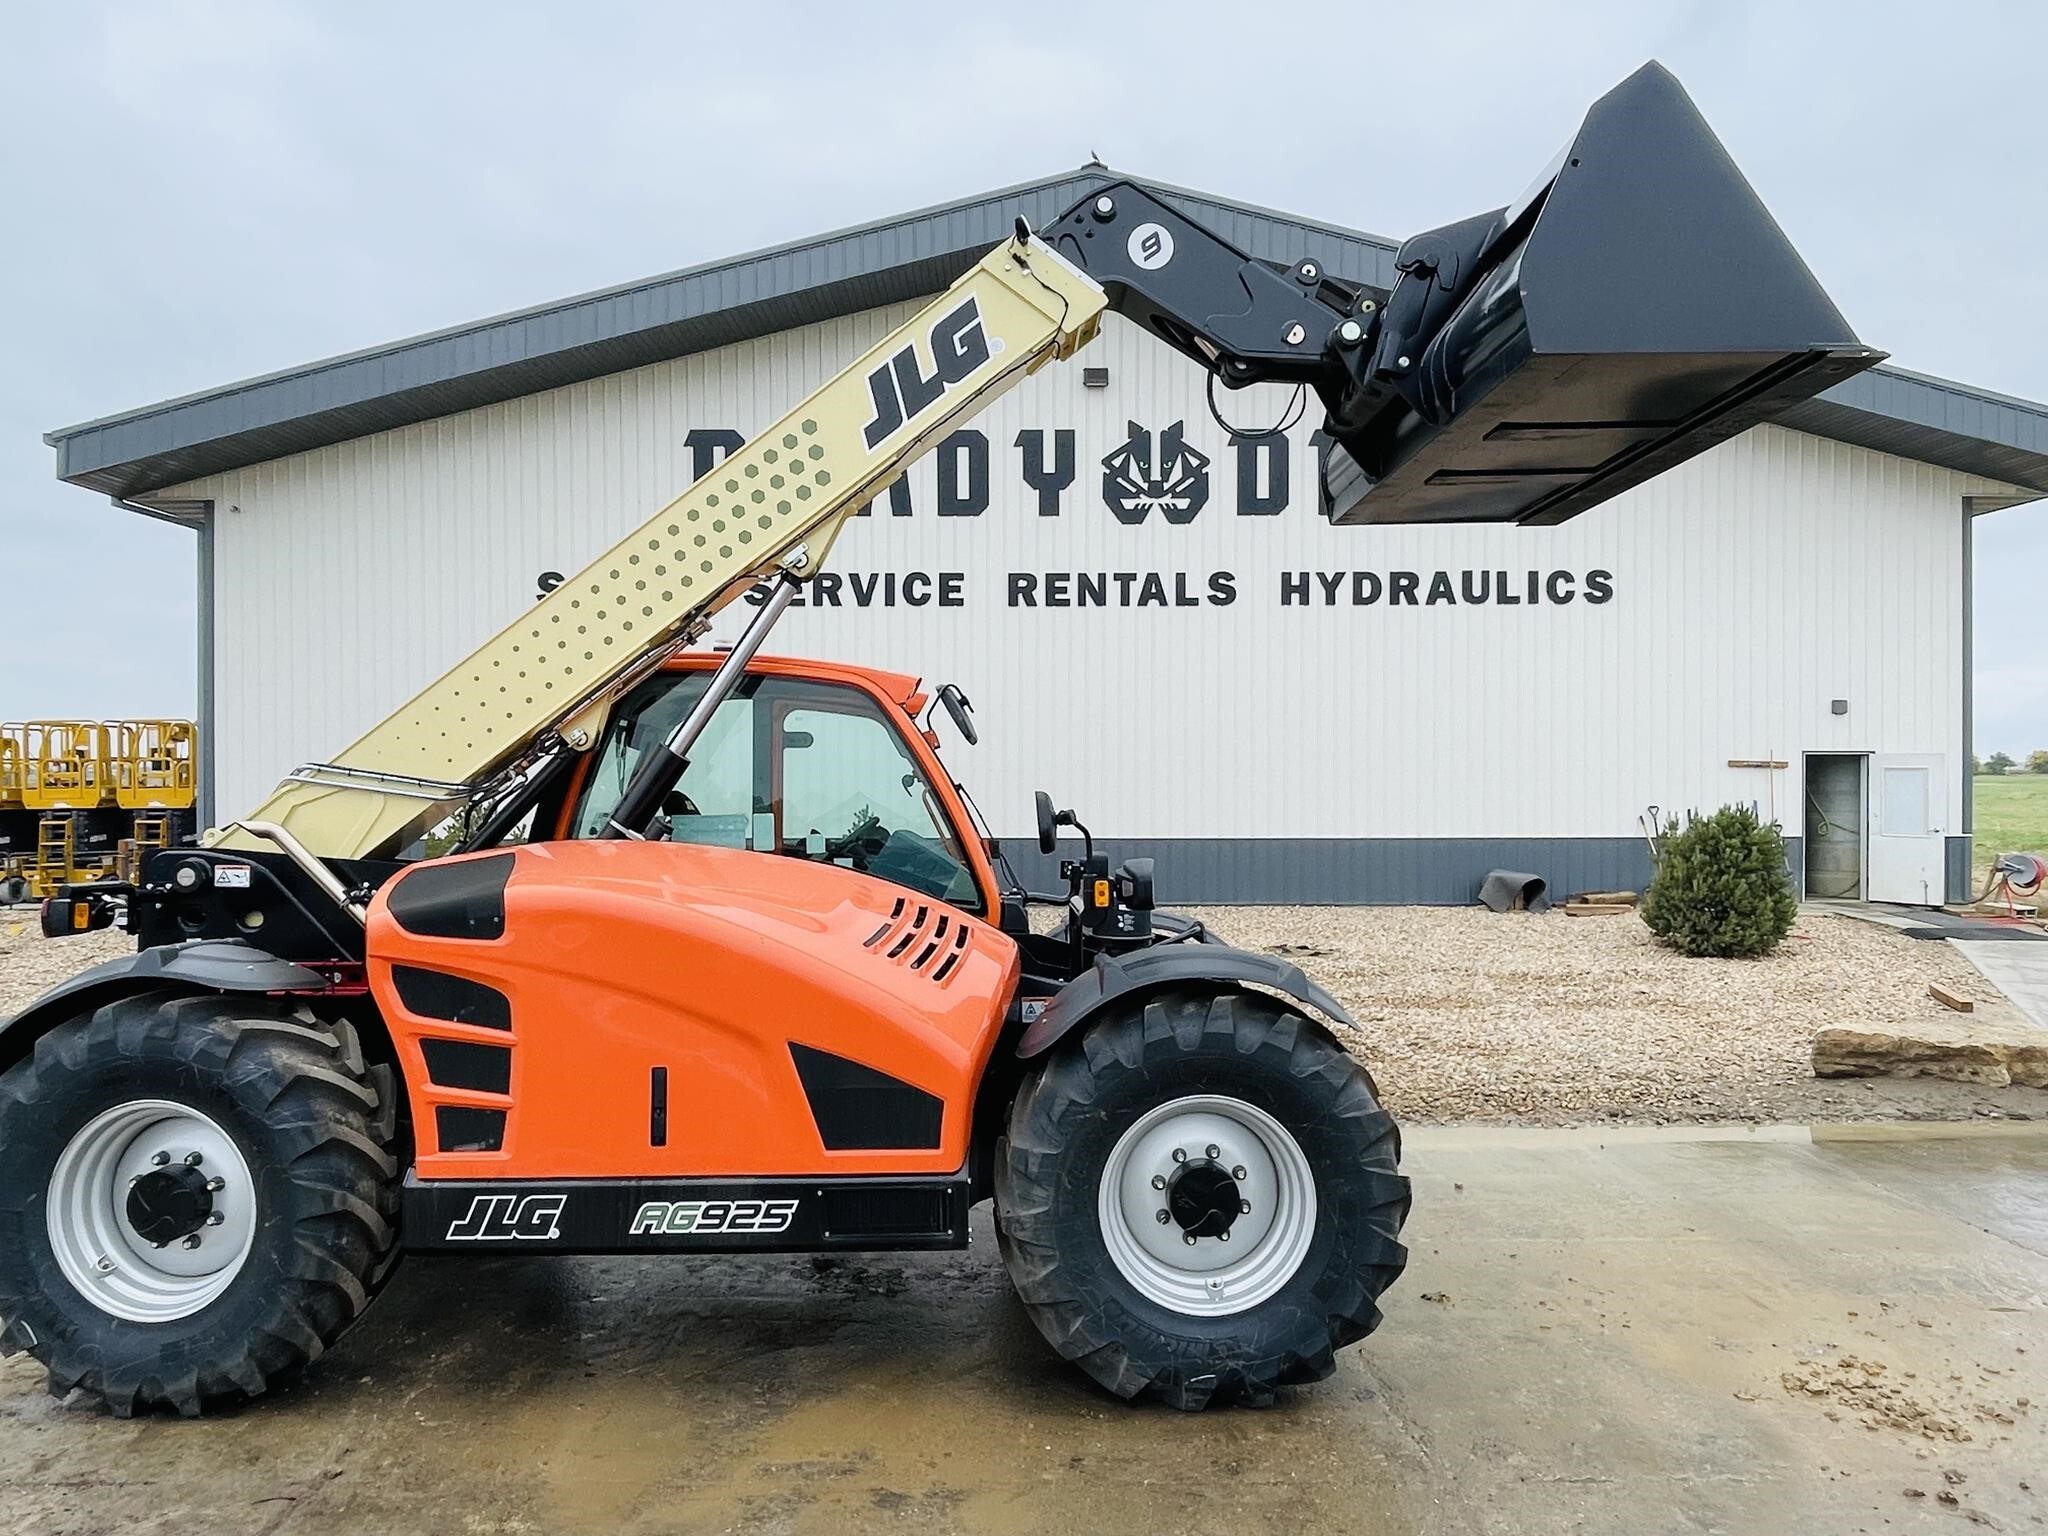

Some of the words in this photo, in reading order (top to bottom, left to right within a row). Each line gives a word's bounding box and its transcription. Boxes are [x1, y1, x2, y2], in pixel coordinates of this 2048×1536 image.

[862, 294, 992, 453] JLG
[1007, 571, 1236, 607] RENTALS
[1281, 569, 1614, 606] HYDRAULICS
[445, 1194, 567, 1241] JLG
[629, 1199, 799, 1235] AG925
